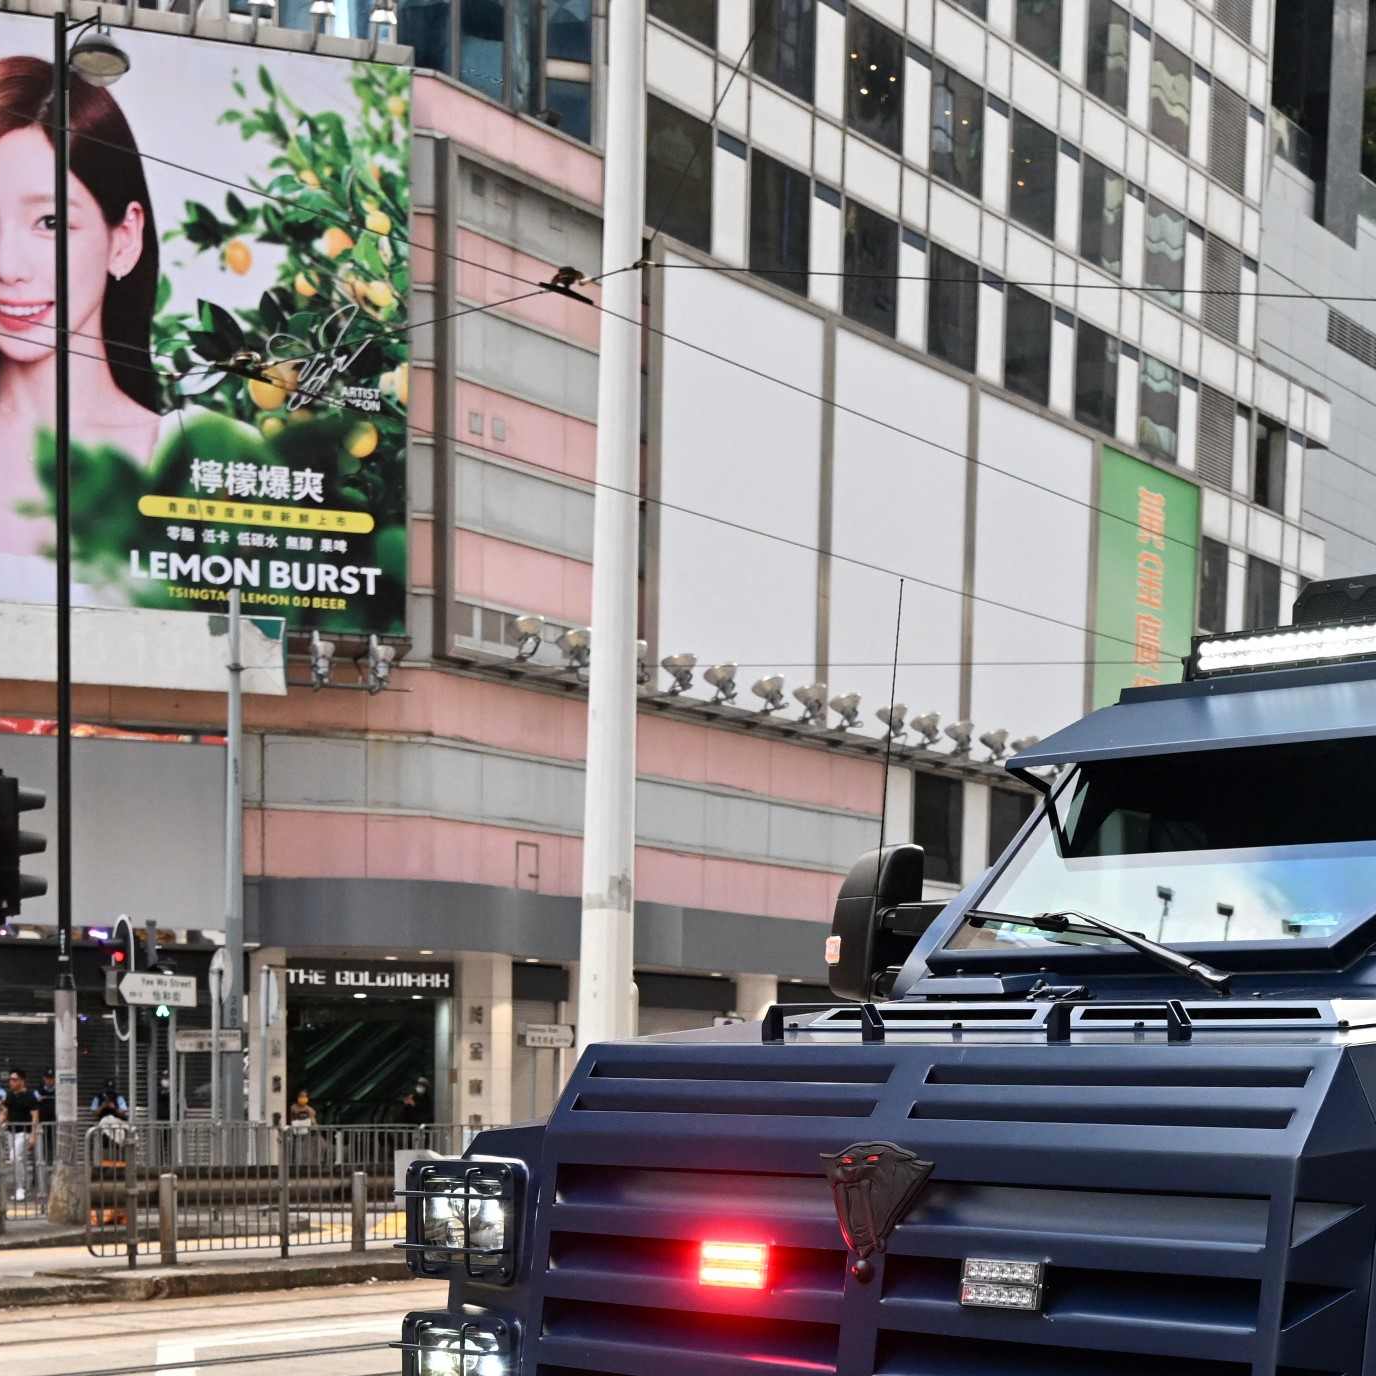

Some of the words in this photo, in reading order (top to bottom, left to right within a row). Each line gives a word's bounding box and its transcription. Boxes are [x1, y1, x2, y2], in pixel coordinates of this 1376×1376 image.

[341, 386, 380, 400] ARTIST
[189, 458, 325, 503] 檸檬爆爽
[201, 529, 230, 545] 低卡
[129, 549, 261, 588] LEMON
[269, 560, 382, 596] BURST
[240, 592, 290, 607] LEMON
[312, 597, 347, 610] BEER
[170, 979, 192, 988] Street
[286, 968, 327, 985] THE
[335, 970, 450, 988] GOLDMARK
